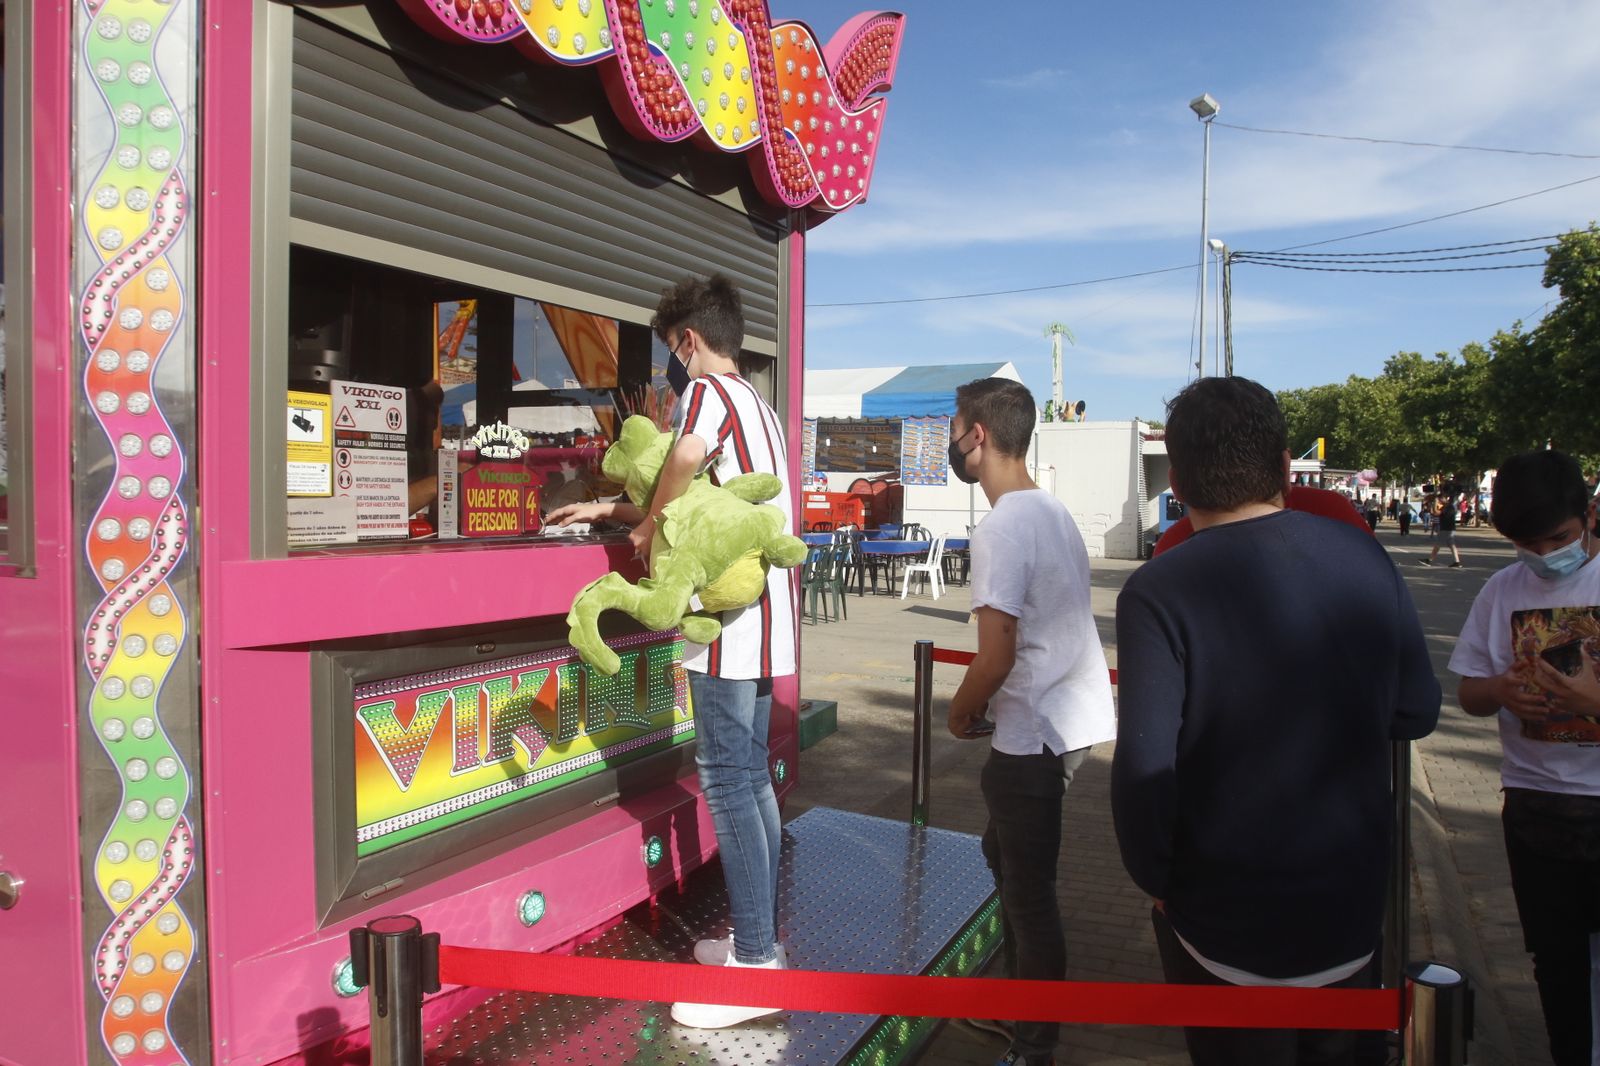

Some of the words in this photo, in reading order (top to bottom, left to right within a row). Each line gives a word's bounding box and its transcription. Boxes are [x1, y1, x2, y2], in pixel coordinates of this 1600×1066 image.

[341, 386, 403, 400] VIKINGO
[355, 399, 382, 410] XXL
[467, 488, 497, 508] VIAJE
[498, 488, 519, 508] POR
[526, 491, 537, 515] 4
[469, 512, 518, 531] PERSONA
